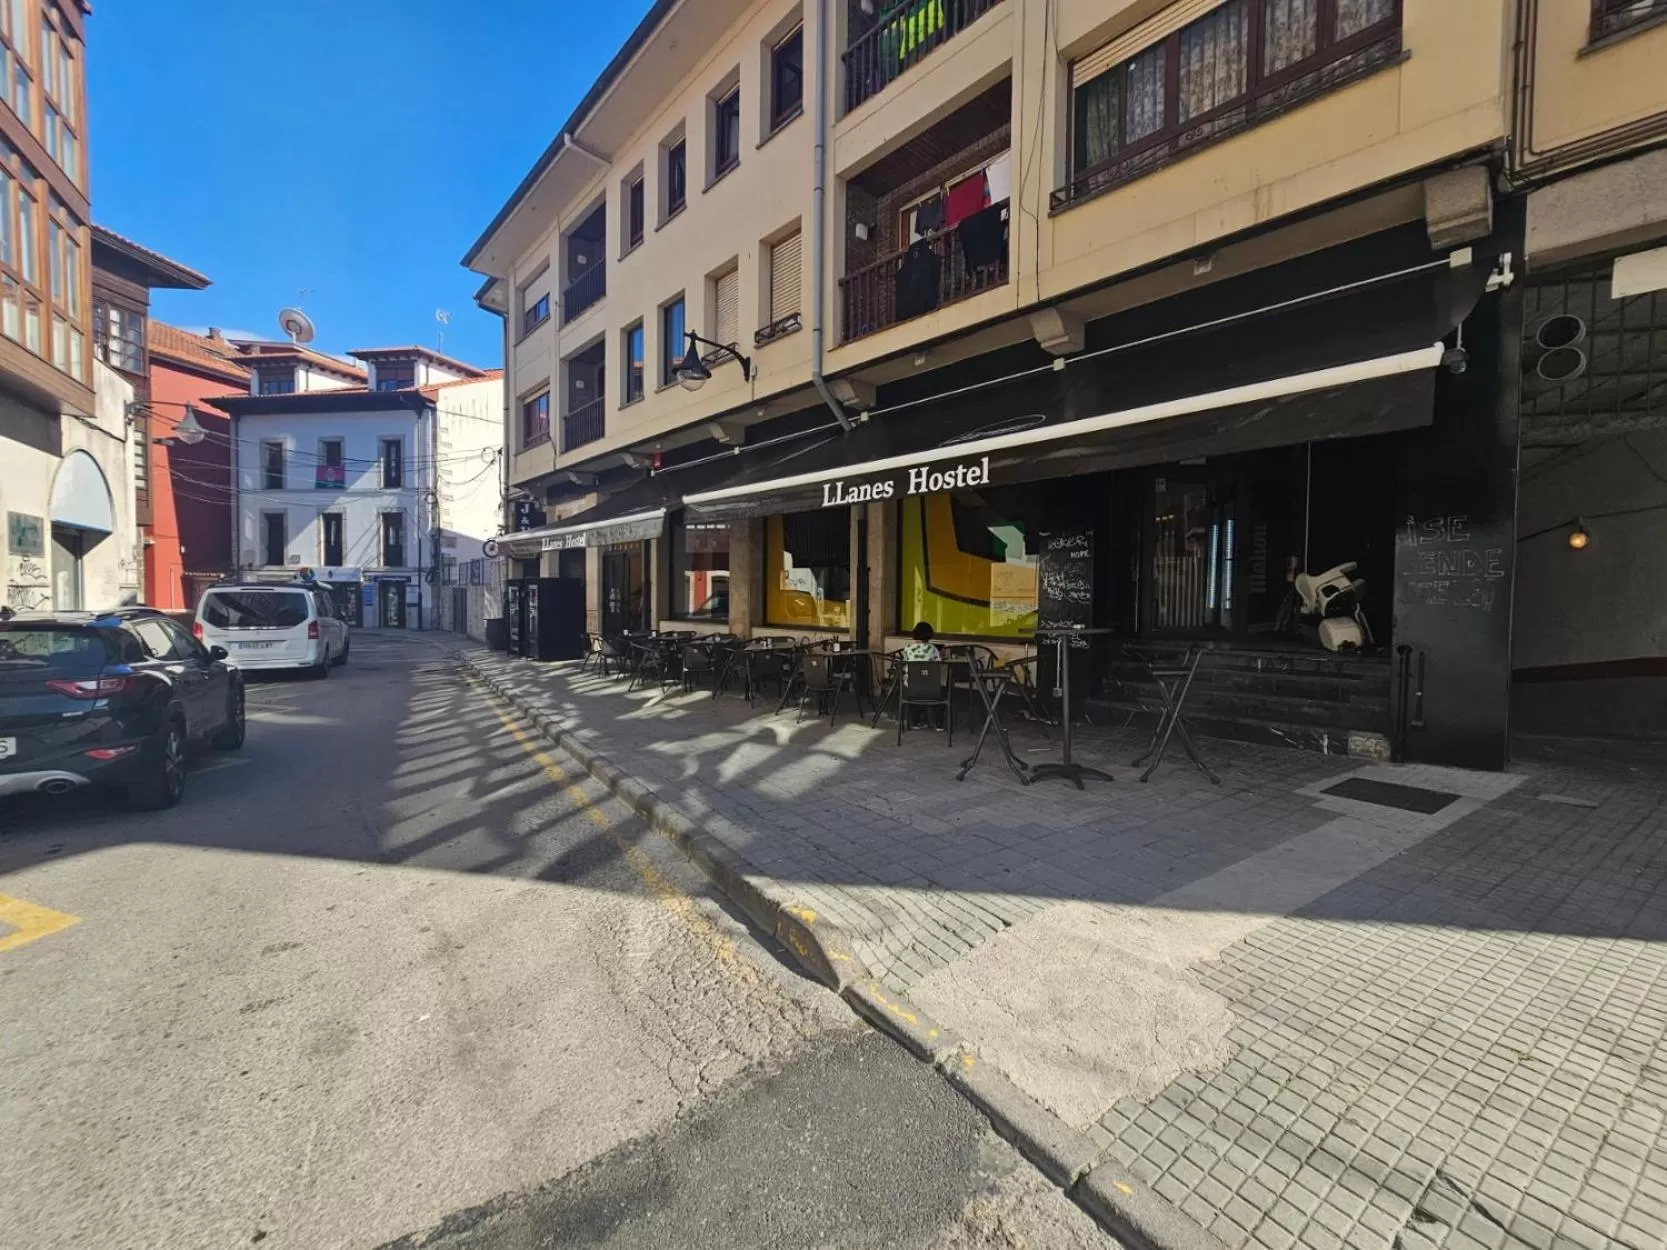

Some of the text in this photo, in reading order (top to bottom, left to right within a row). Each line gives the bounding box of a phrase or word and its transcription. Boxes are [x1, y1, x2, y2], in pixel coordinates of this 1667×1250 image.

[822, 456, 990, 507] LLanes Hostel
[565, 532, 587, 549] Hostel
